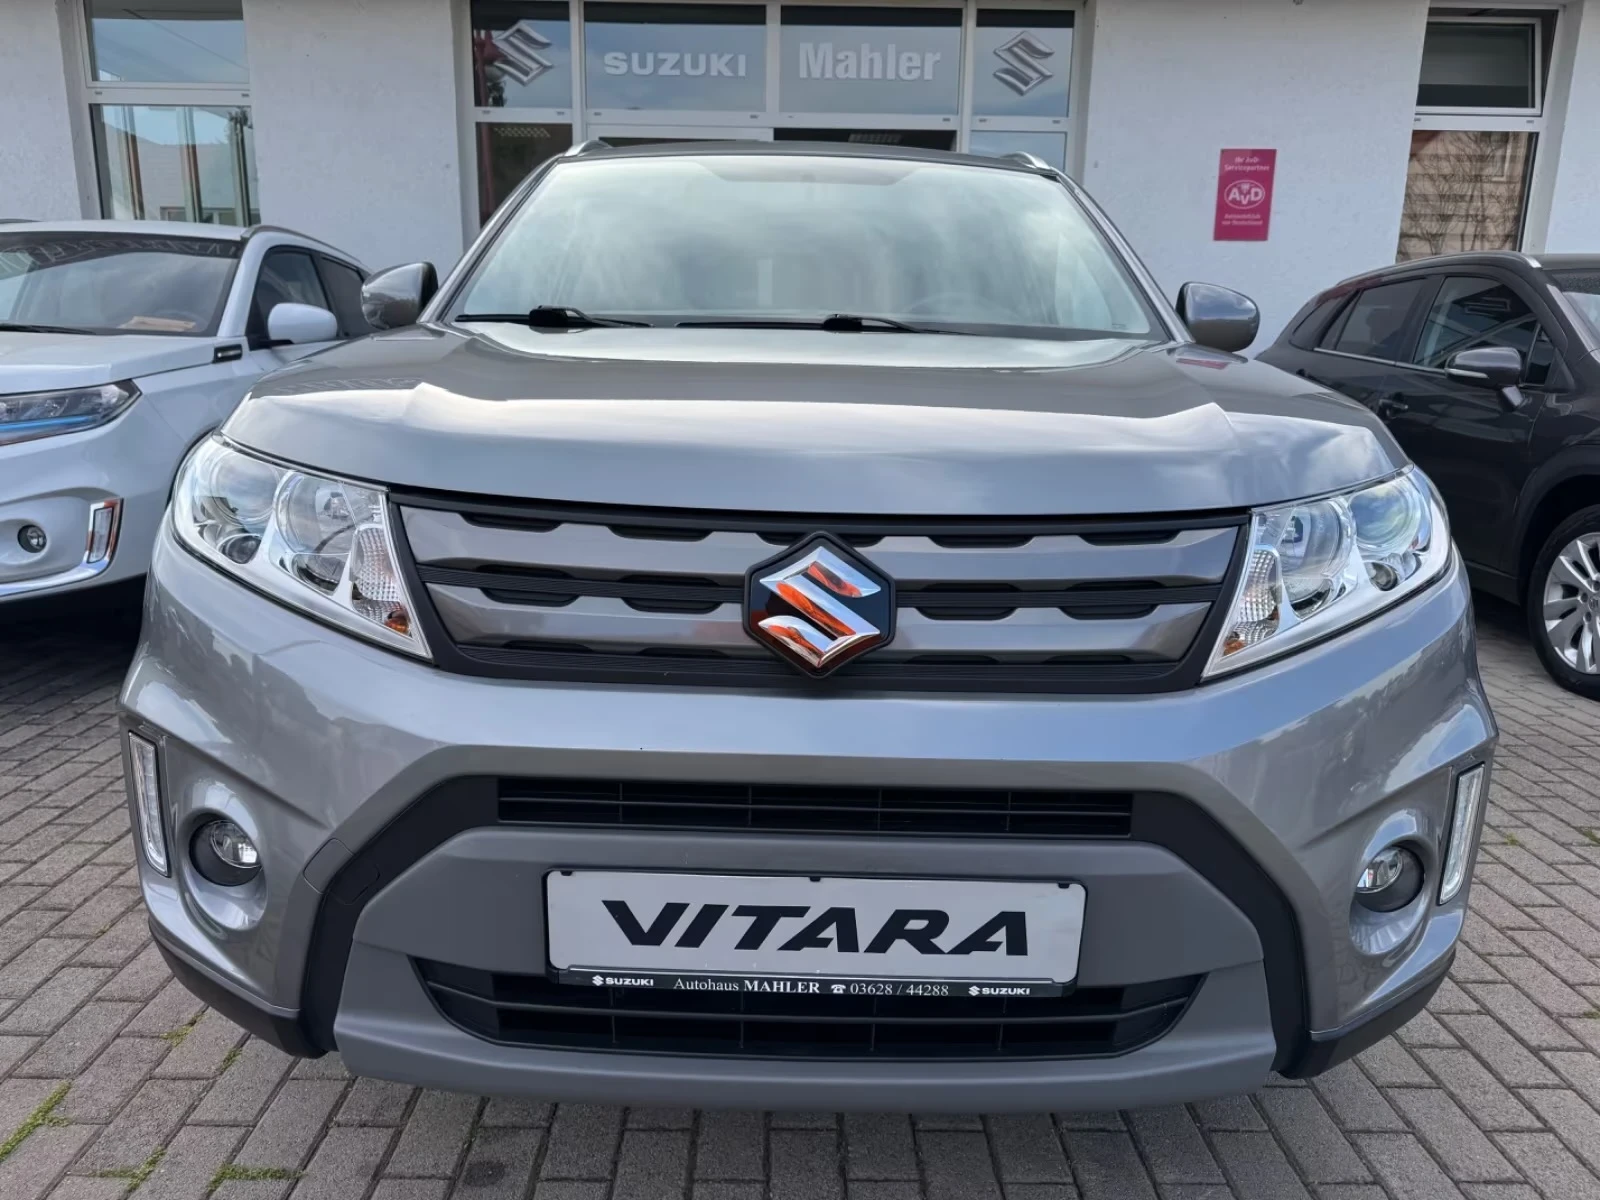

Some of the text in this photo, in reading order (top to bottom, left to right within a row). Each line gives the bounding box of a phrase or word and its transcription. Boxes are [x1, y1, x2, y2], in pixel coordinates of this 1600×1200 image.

[604, 42, 940, 81] SUZUKI Mahler
[1228, 187, 1262, 205] AvD
[601, 899, 1028, 956] VITARA
[605, 976, 654, 987] SUZUKI
[673, 978, 739, 992] Autohaus
[743, 979, 820, 994] MAHLER
[849, 983, 893, 995] 03628
[906, 984, 949, 996] 44288
[982, 987, 1031, 996] SUZUKI
